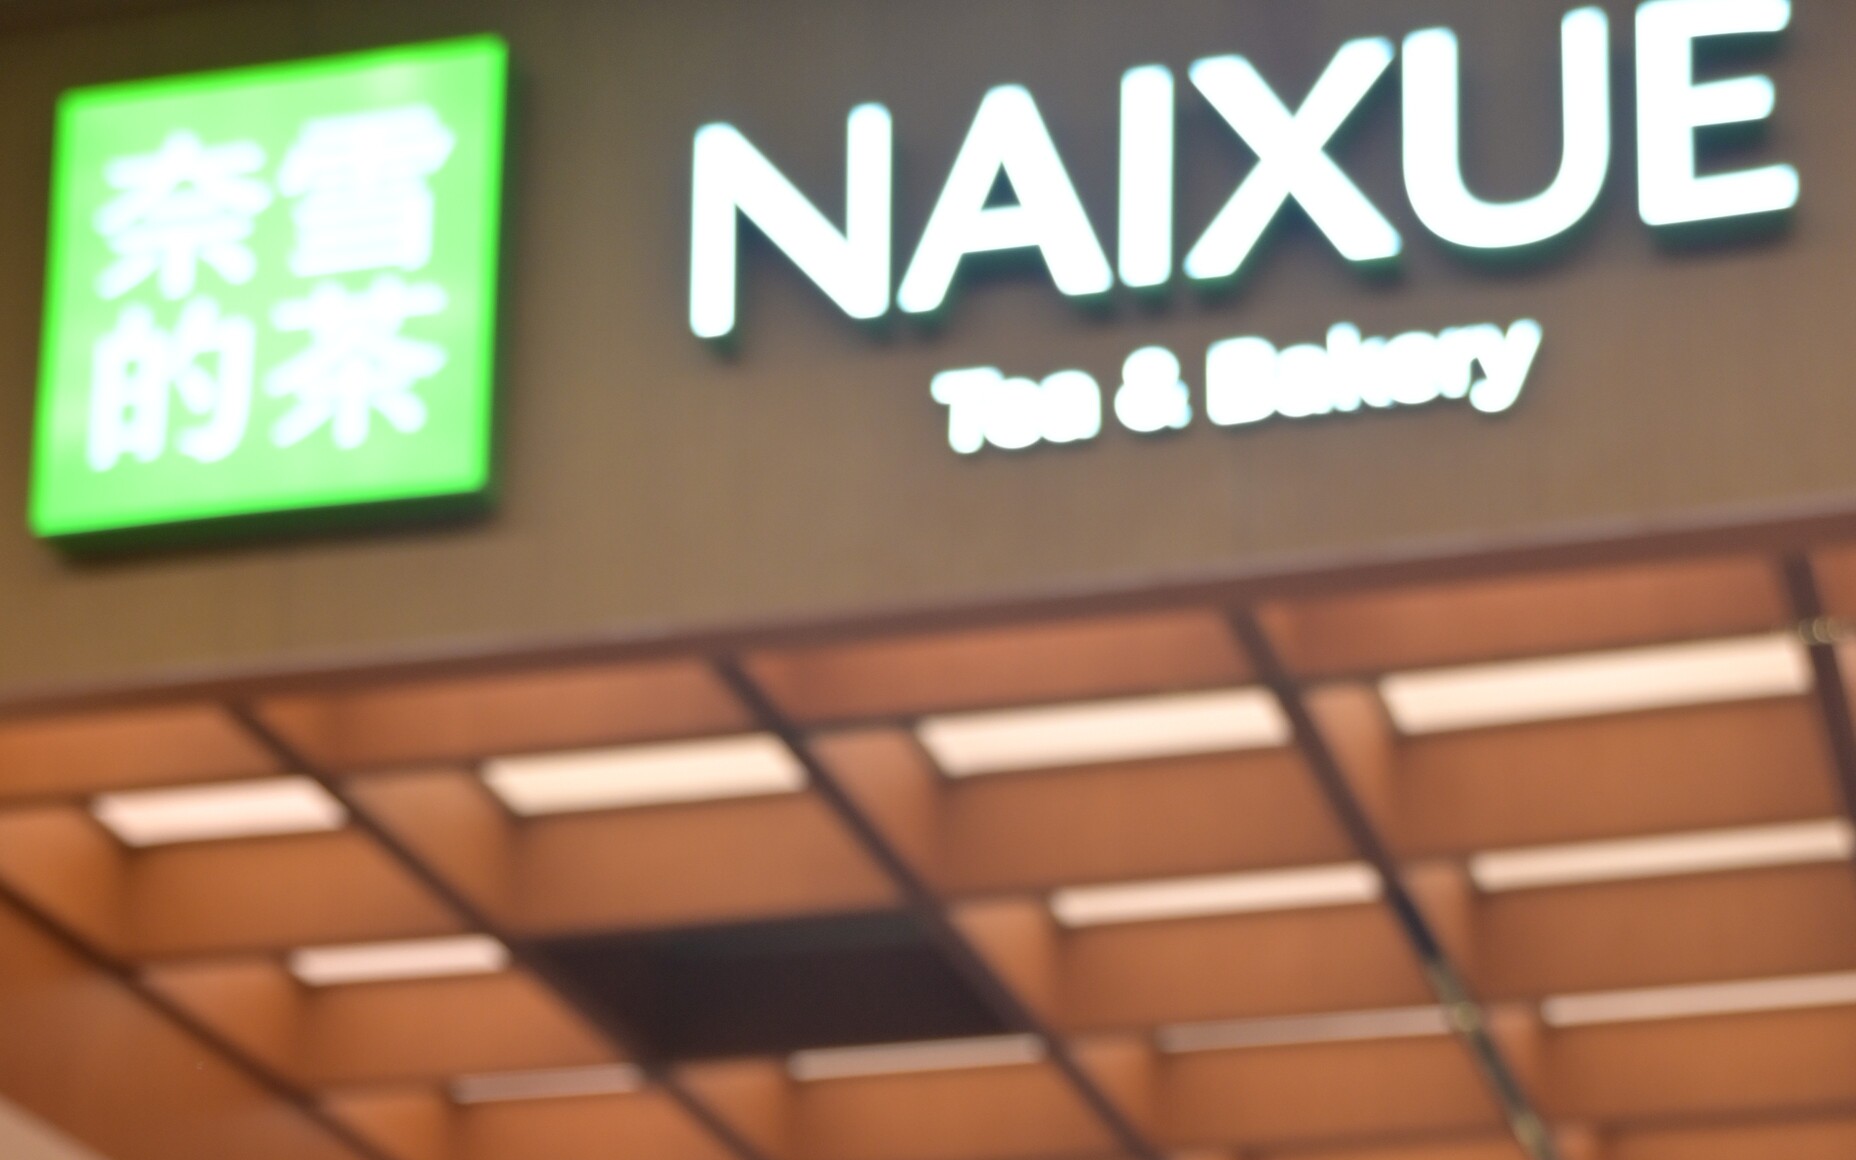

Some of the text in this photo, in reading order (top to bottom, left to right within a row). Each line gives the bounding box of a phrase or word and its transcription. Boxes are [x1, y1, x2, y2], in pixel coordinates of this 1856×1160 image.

[93, 103, 456, 300] 奈雪
[689, 0, 1800, 338] NAIXUE
[86, 273, 450, 472] 的茶
